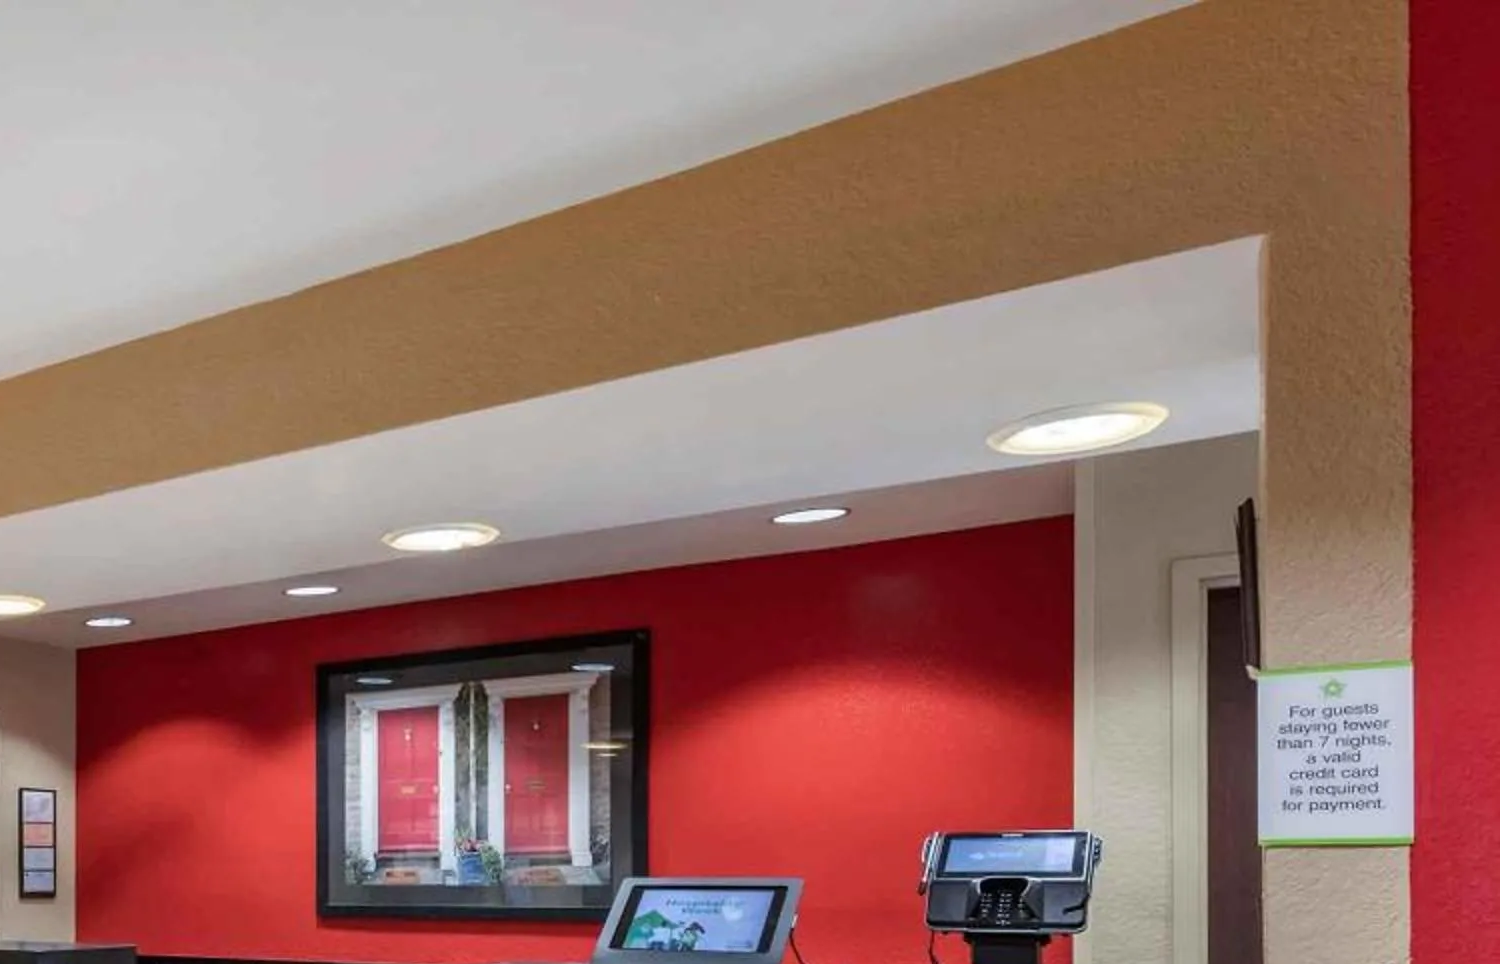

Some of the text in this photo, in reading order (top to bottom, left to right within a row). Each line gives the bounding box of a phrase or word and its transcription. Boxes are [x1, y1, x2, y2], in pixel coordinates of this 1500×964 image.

[1289, 703, 1379, 719] For guests
[1278, 719, 1390, 736] staying fewer
[1277, 738, 1313, 749] than
[1319, 735, 1329, 748] 7
[1306, 750, 1361, 764] a valid
[1289, 765, 1379, 780] credit card
[1289, 781, 1379, 797] is required
[1282, 799, 1303, 811] for
